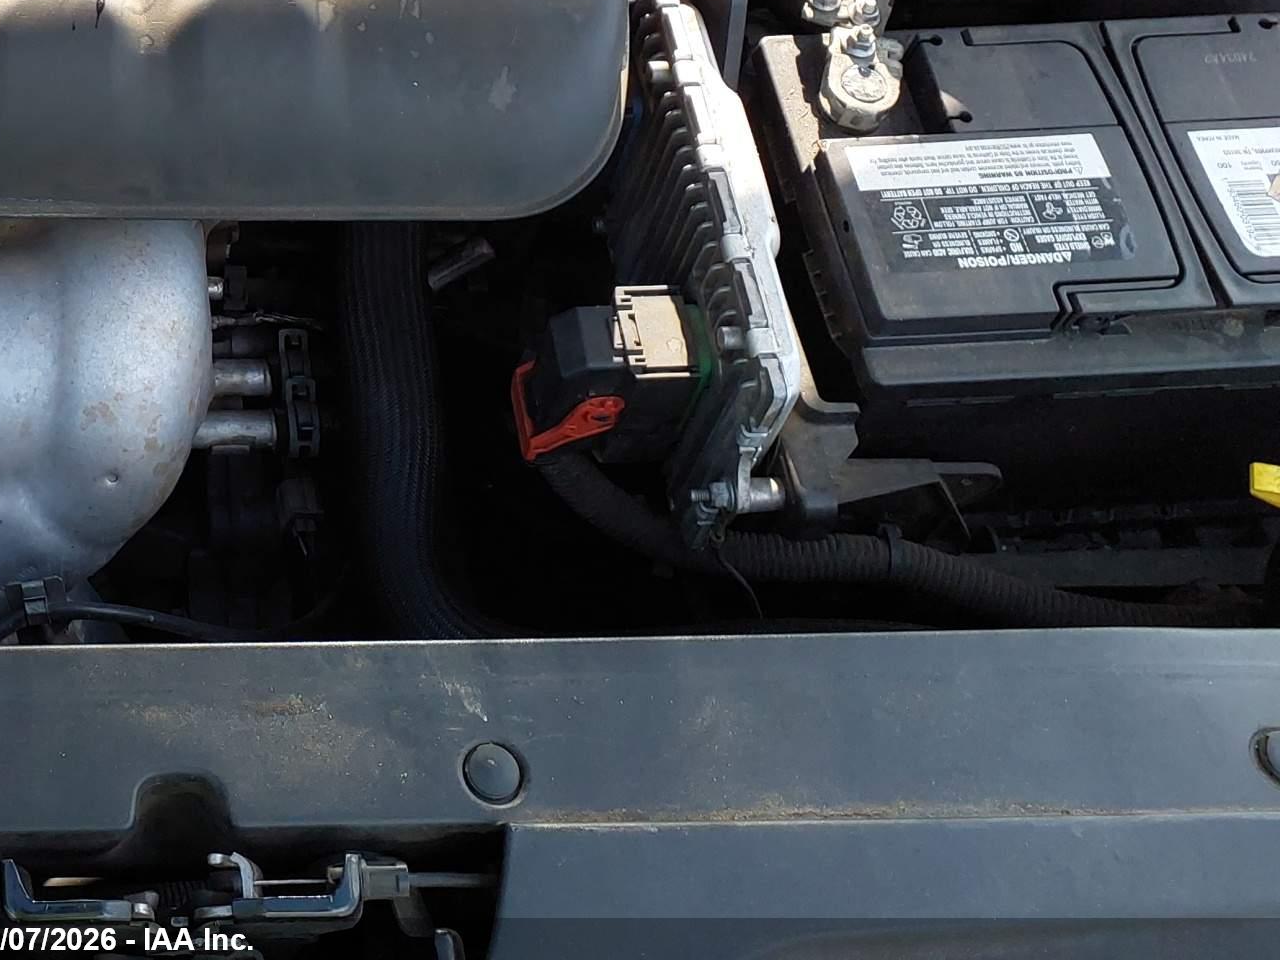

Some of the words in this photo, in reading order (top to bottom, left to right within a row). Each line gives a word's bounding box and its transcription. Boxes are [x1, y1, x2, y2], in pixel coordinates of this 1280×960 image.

[1019, 182, 1040, 190] REACH
[1039, 181, 1052, 189] THE
[1074, 179, 1091, 187] KEEP
[1008, 242, 1023, 251] NO
[956, 251, 1064, 268] DANGER/POISON
